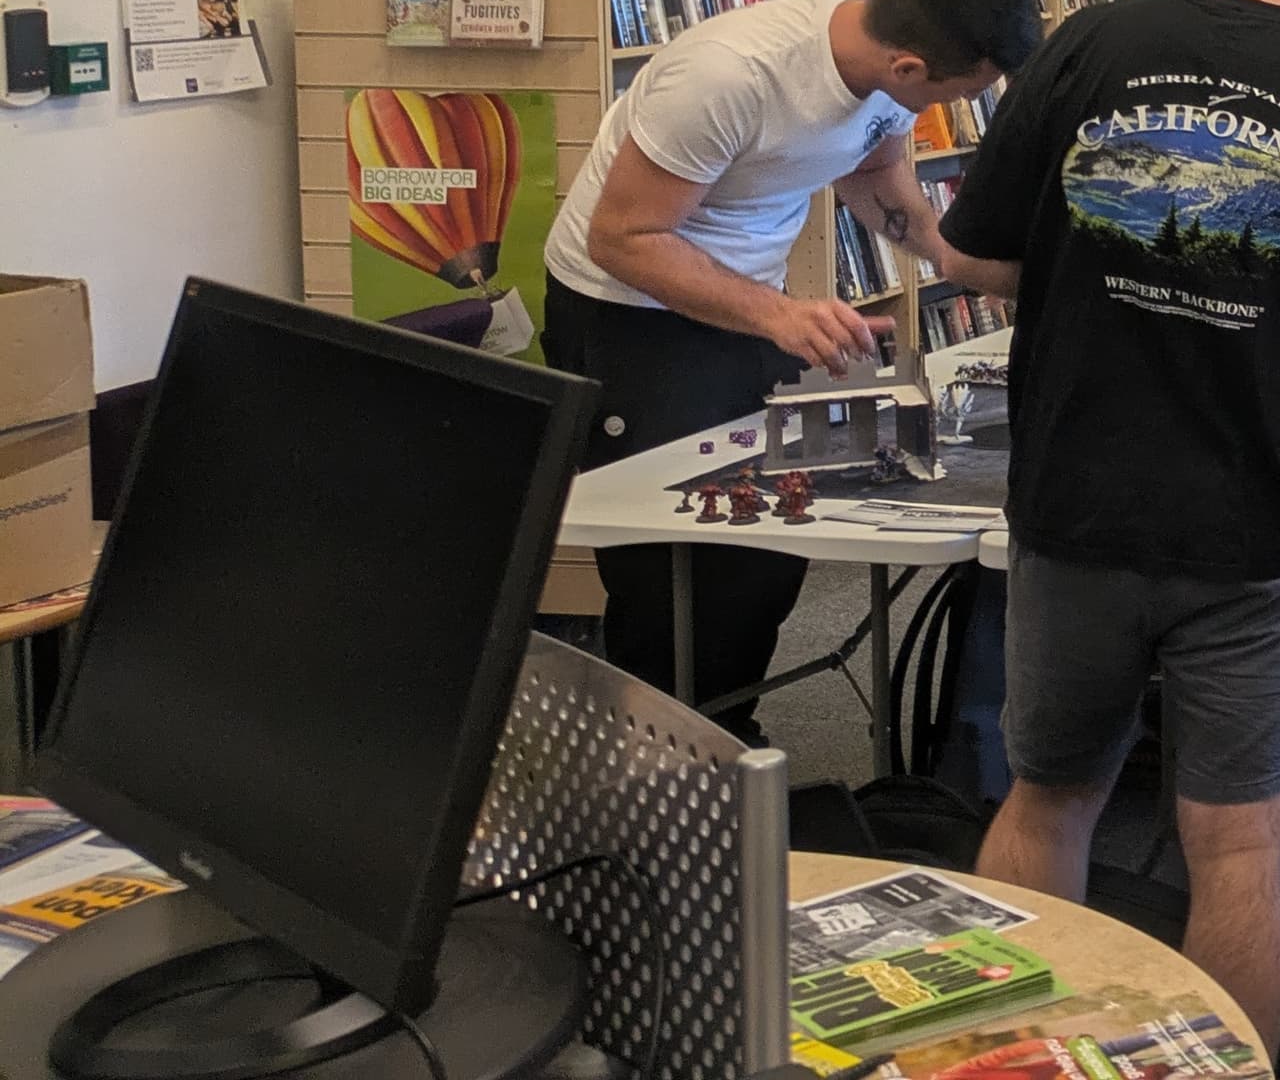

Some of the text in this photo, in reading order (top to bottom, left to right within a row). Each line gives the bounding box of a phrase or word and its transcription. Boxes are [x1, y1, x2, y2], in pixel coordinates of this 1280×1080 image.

[464, 5, 520, 19] FUGITIVES
[1126, 74, 1214, 90] SIERRA
[364, 170, 474, 186] BORROW FOR
[364, 186, 444, 201] BIG IDEAS
[1105, 275, 1172, 301] WESTERN
[1175, 289, 1265, 319] "BACKBONE"
